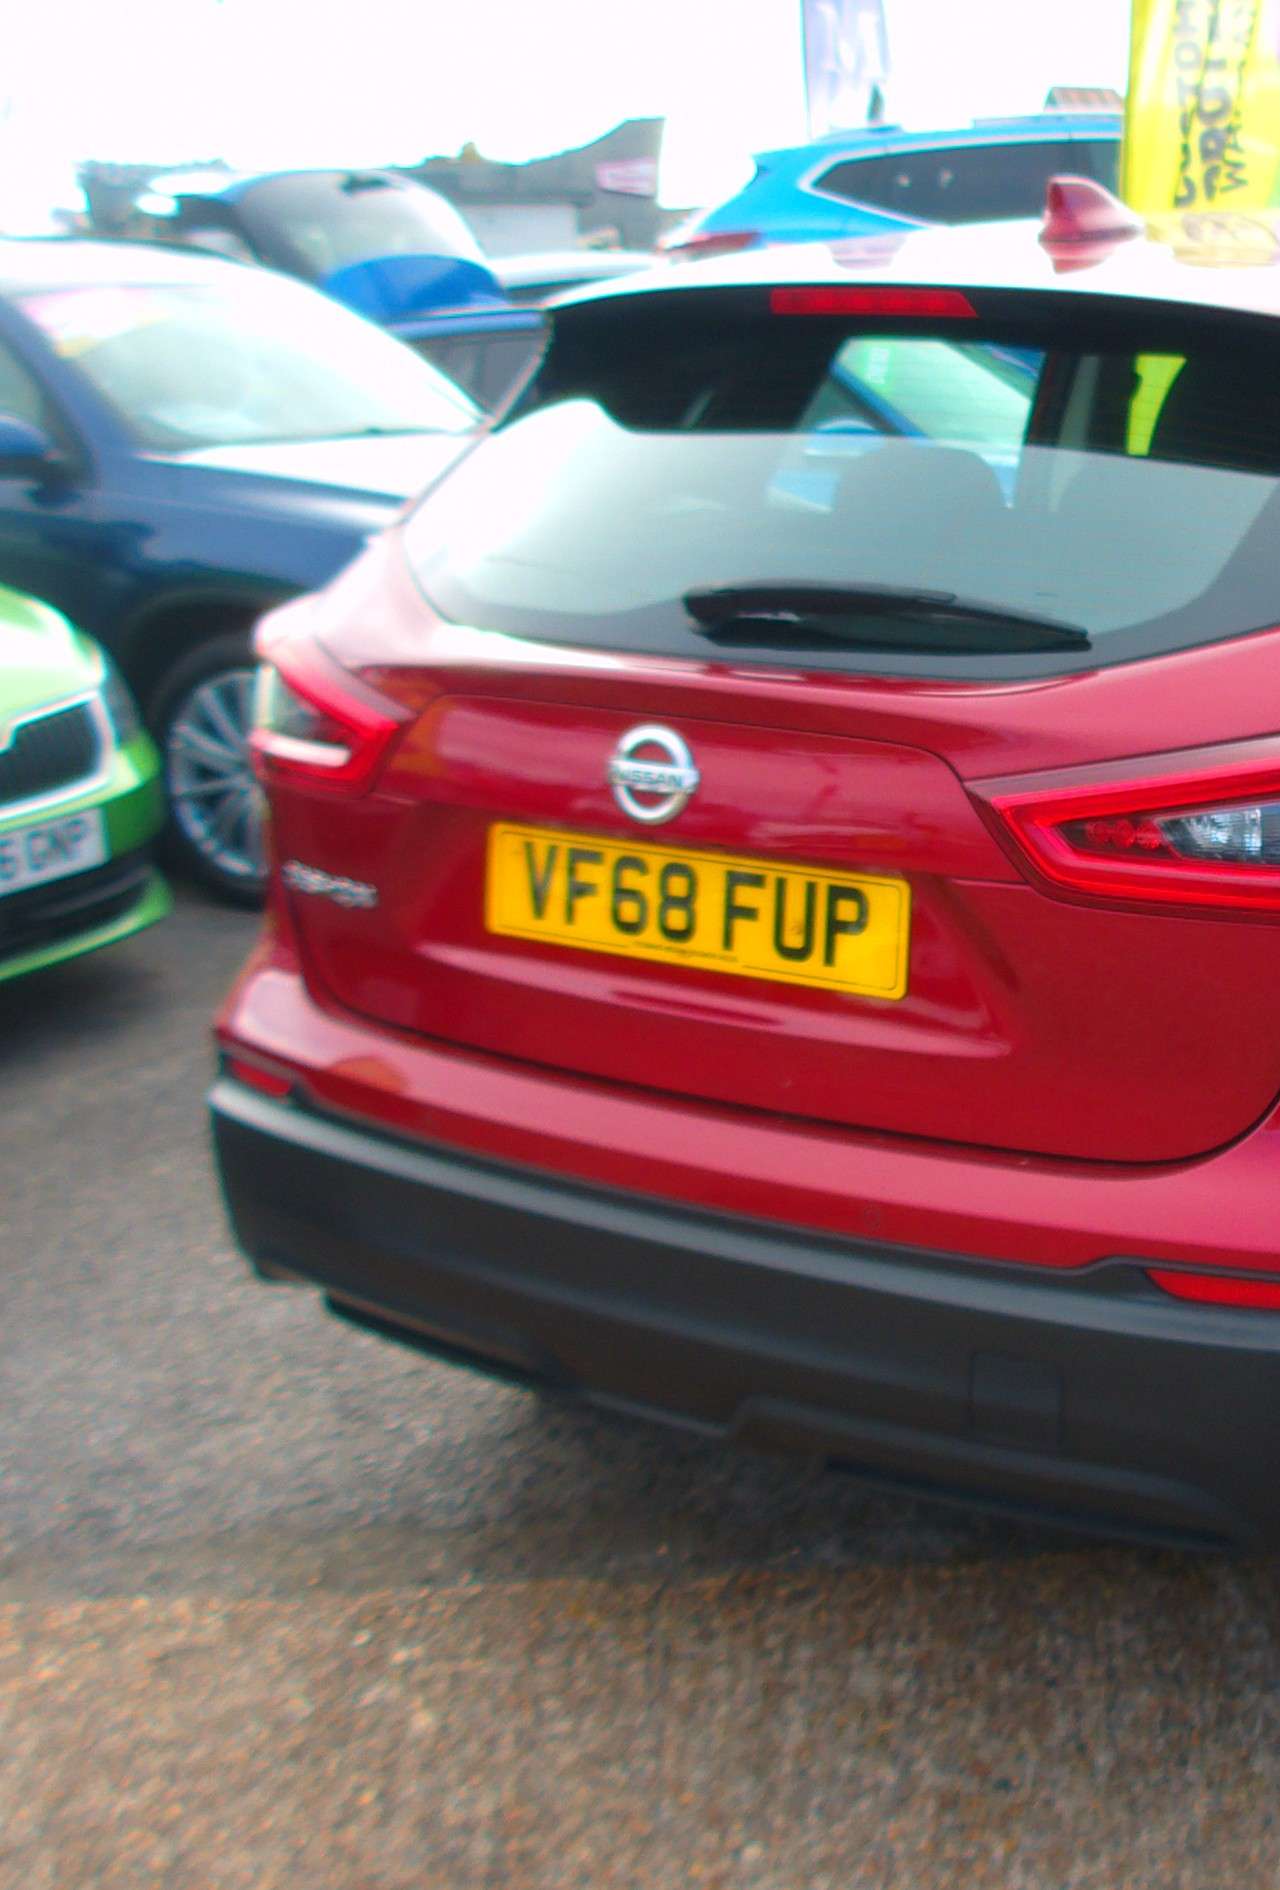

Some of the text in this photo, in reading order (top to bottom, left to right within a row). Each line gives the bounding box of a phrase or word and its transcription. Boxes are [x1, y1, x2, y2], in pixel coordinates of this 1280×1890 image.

[612, 766, 684, 788] NISSAN
[523, 841, 870, 967] VF68 FUP
